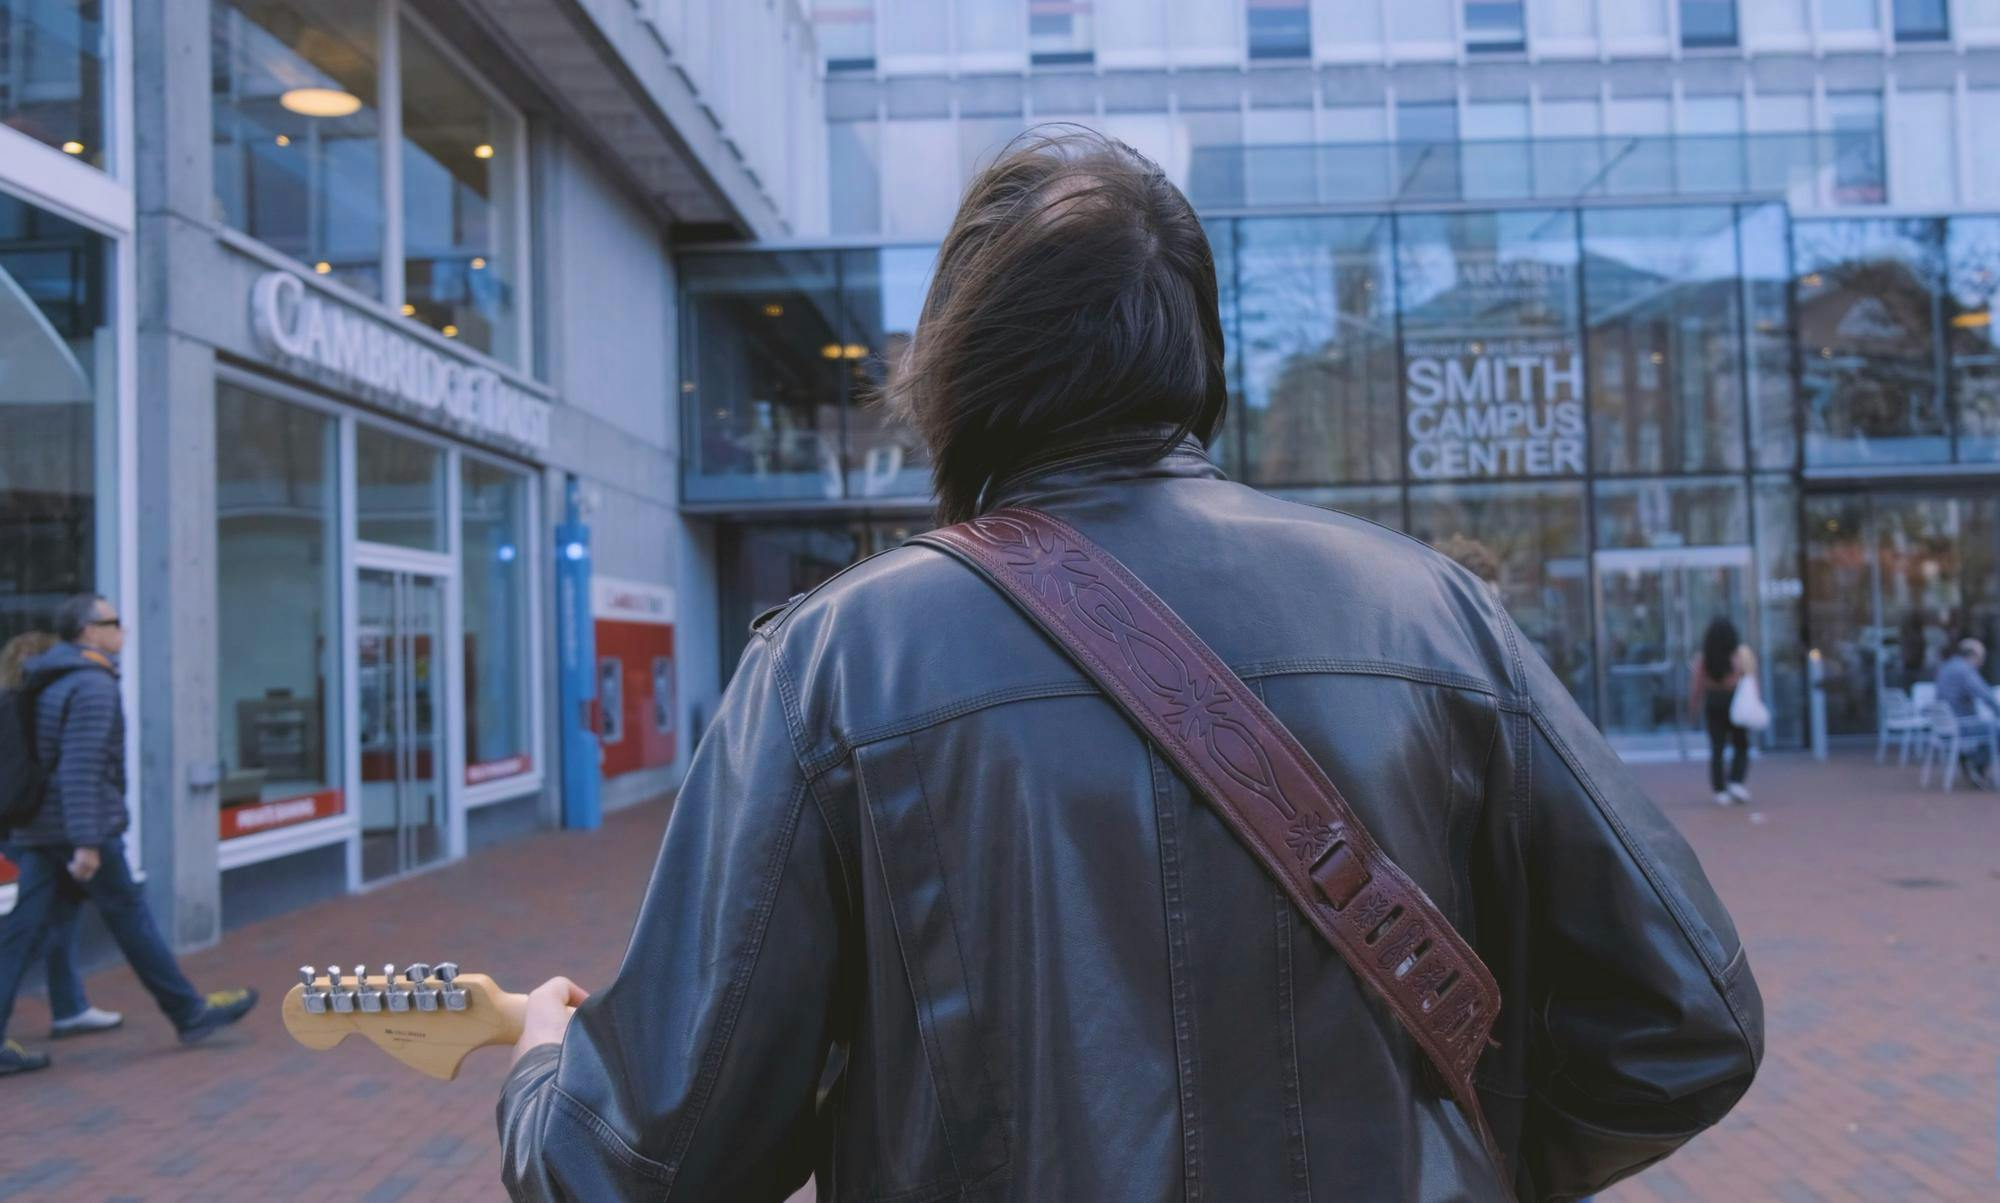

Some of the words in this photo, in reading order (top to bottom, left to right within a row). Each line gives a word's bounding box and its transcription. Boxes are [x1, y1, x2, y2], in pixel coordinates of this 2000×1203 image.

[1407, 353, 1583, 405] SMITH
[1407, 401, 1584, 440] CAMPUS
[1409, 439, 1584, 479] CENTER
